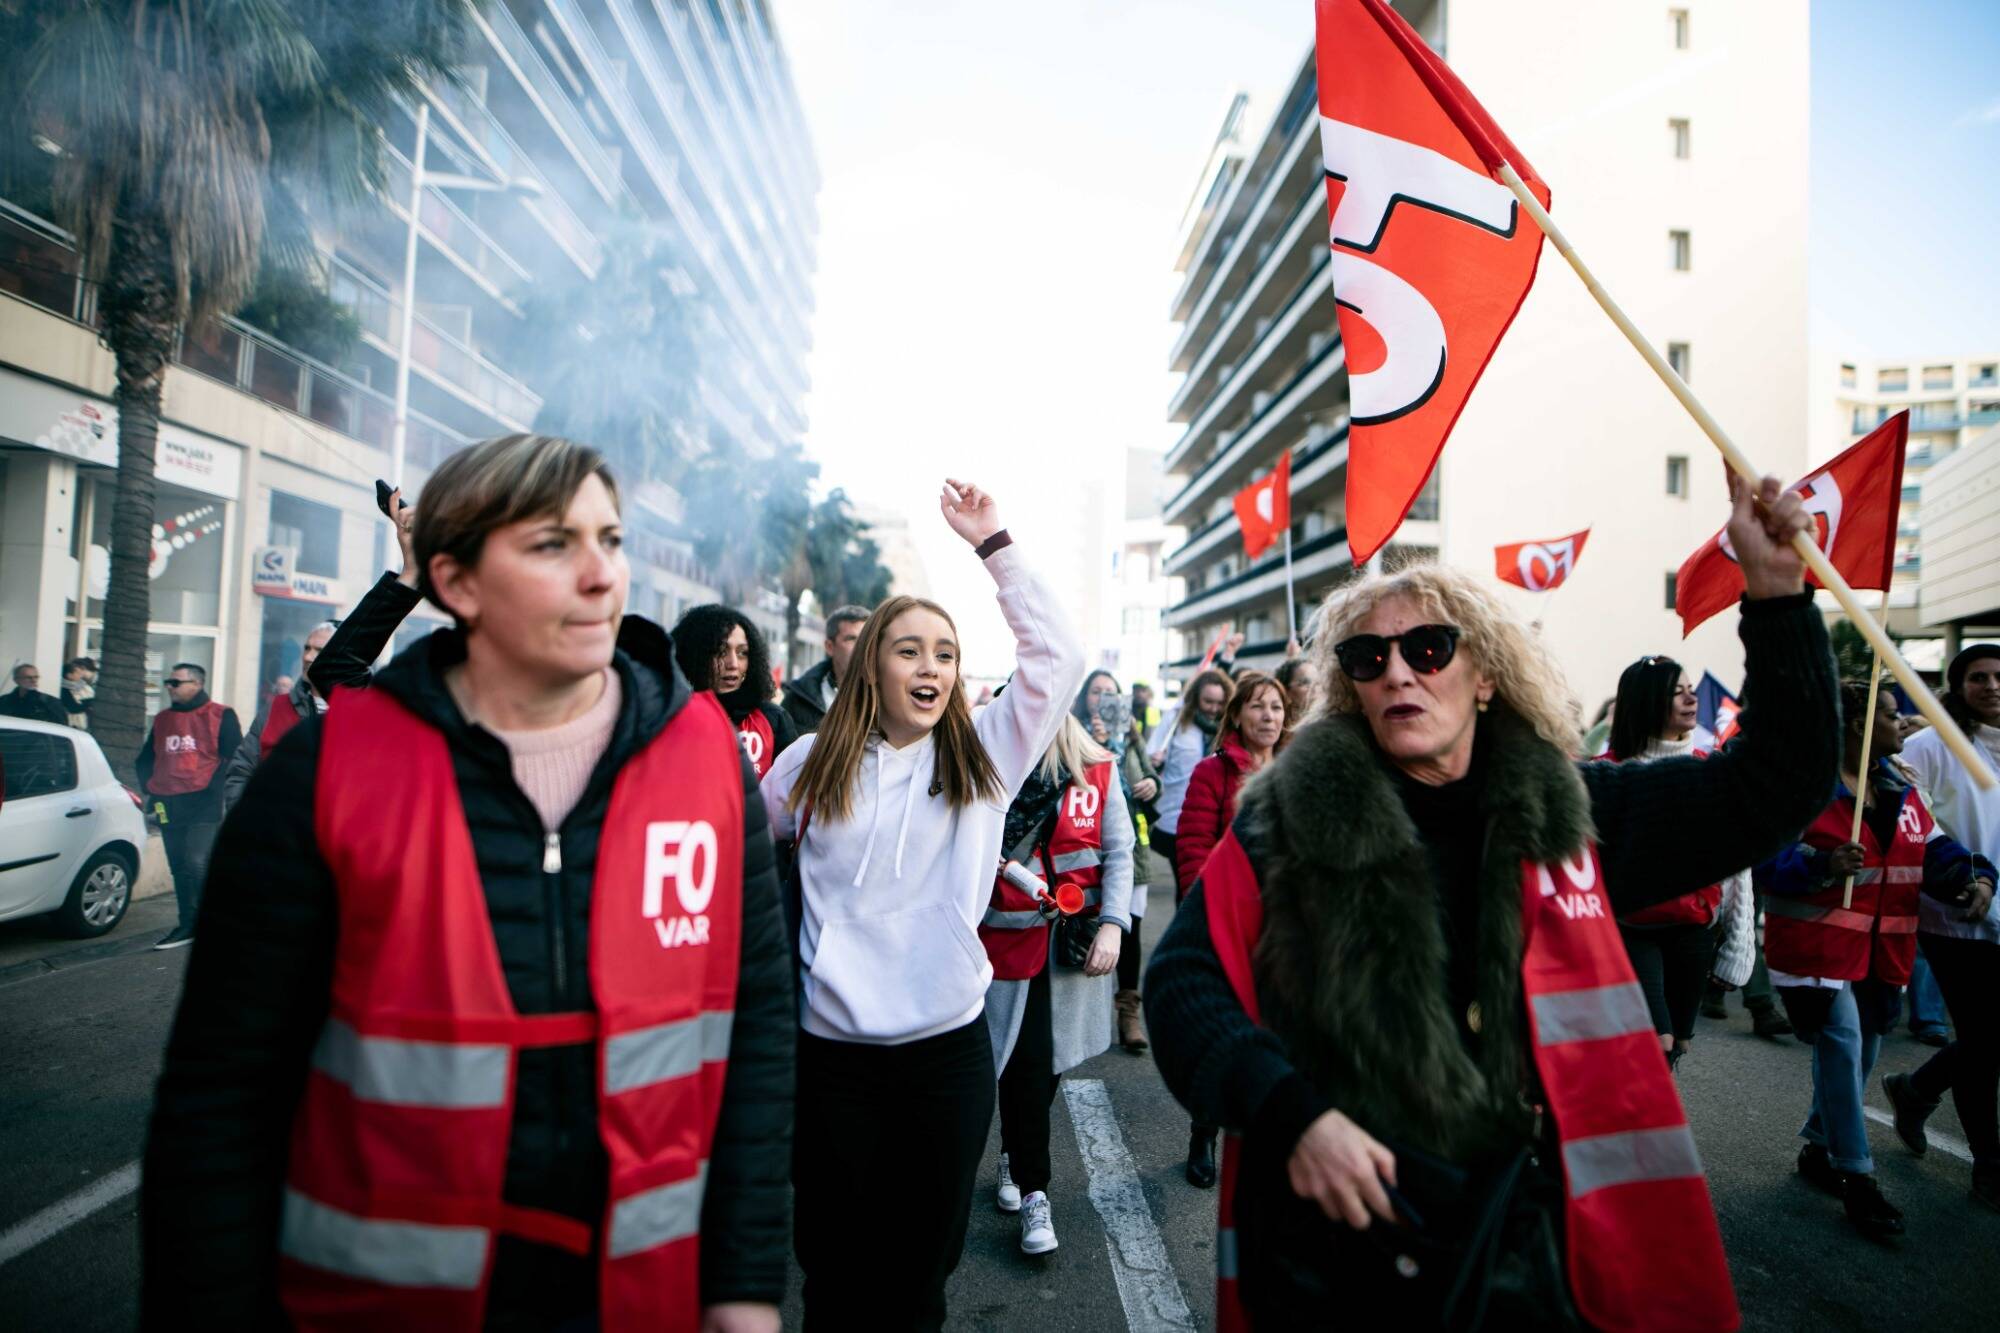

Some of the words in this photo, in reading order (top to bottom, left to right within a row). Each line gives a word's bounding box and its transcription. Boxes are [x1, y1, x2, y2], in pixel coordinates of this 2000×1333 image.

[1068, 785, 1099, 817] FO
[1072, 817, 1095, 829] VAR
[1906, 833, 1925, 844] VAR
[642, 820, 718, 918] FO
[1554, 893, 1605, 920] VAR
[654, 914, 710, 949] VAR
